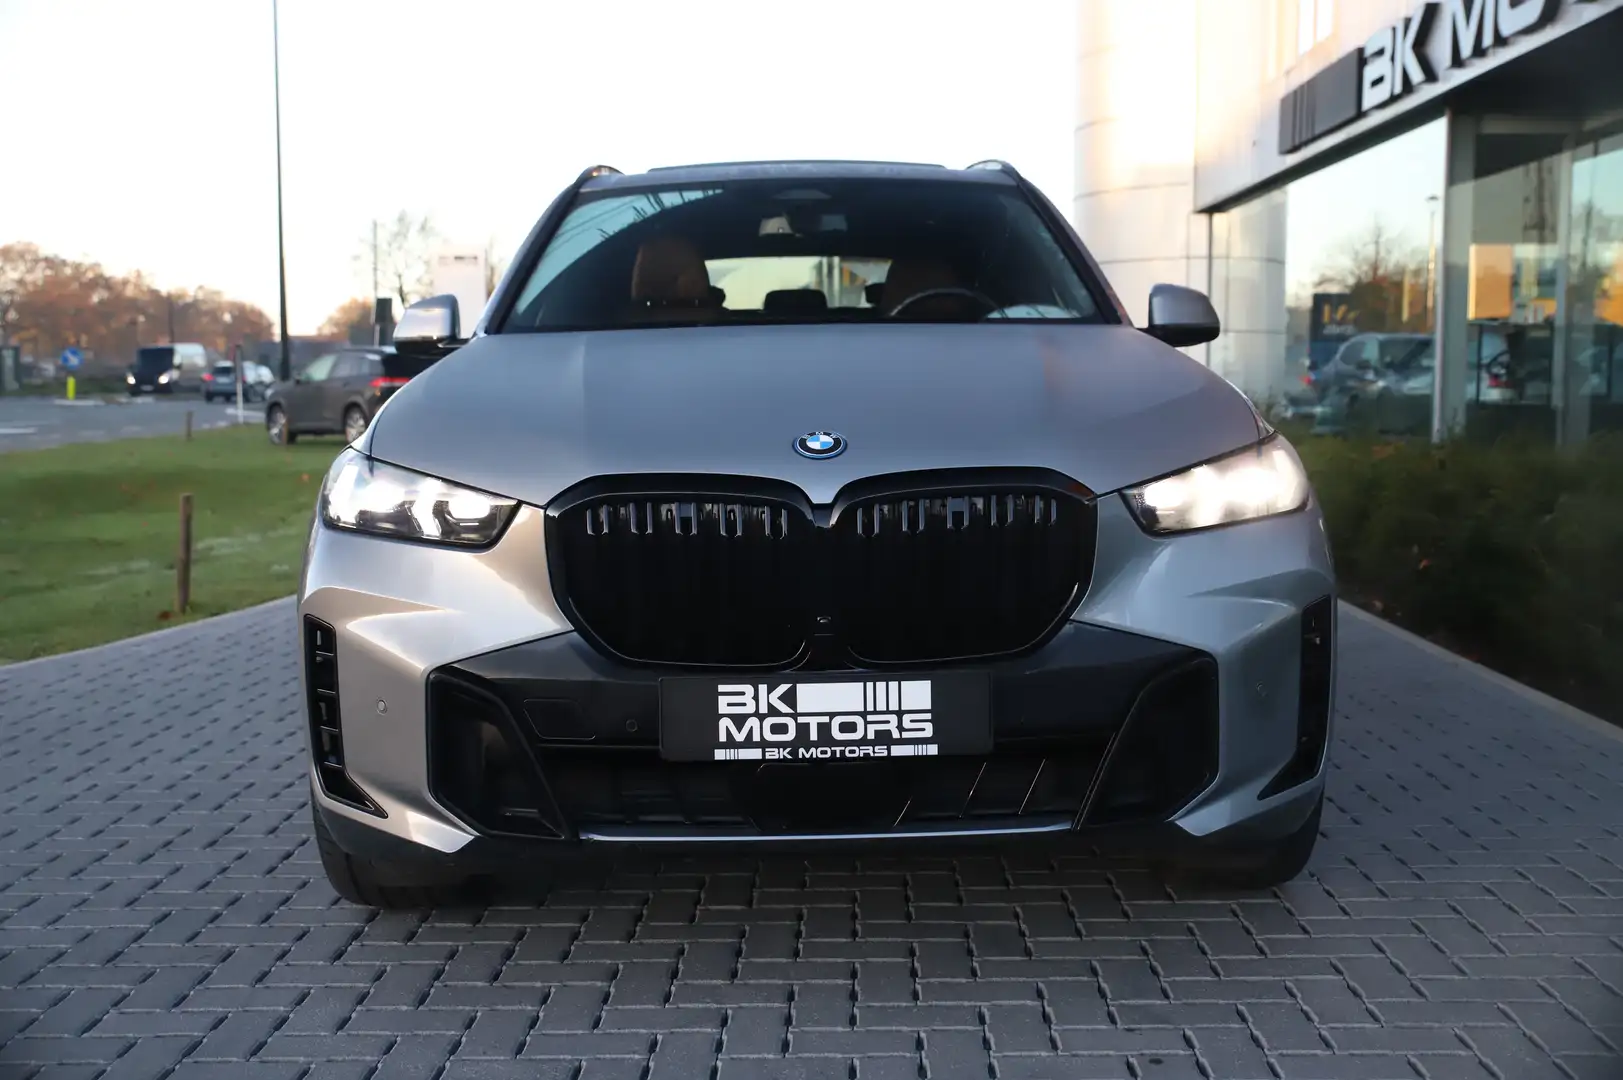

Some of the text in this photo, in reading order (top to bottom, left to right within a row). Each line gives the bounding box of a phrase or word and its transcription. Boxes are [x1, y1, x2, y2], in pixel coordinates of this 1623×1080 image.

[1361, 3, 1428, 112] BK
[717, 684, 796, 714] BK
[718, 713, 933, 742] MOTORS
[765, 746, 888, 759] BK MOTORS
